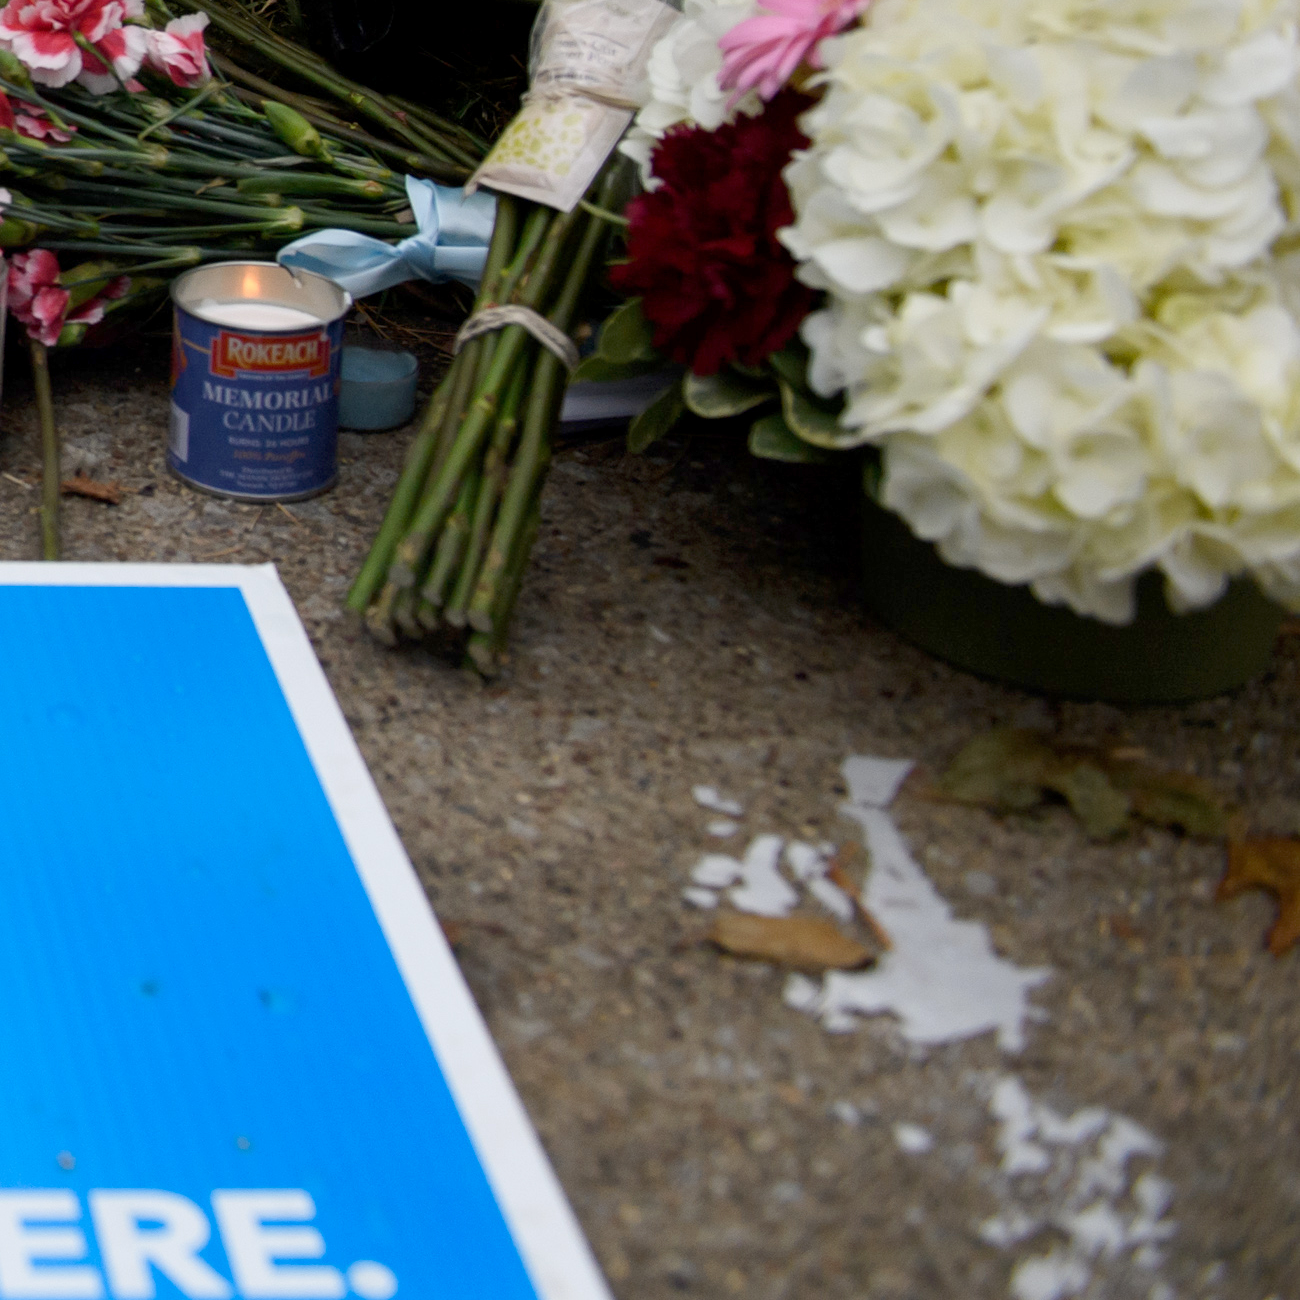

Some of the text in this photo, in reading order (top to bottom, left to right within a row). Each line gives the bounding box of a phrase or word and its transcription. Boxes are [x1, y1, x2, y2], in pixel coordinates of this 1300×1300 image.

[228, 338, 320, 370] ROKEACH
[203, 381, 332, 410] MEMORIAL
[222, 411, 317, 433] CANDLE
